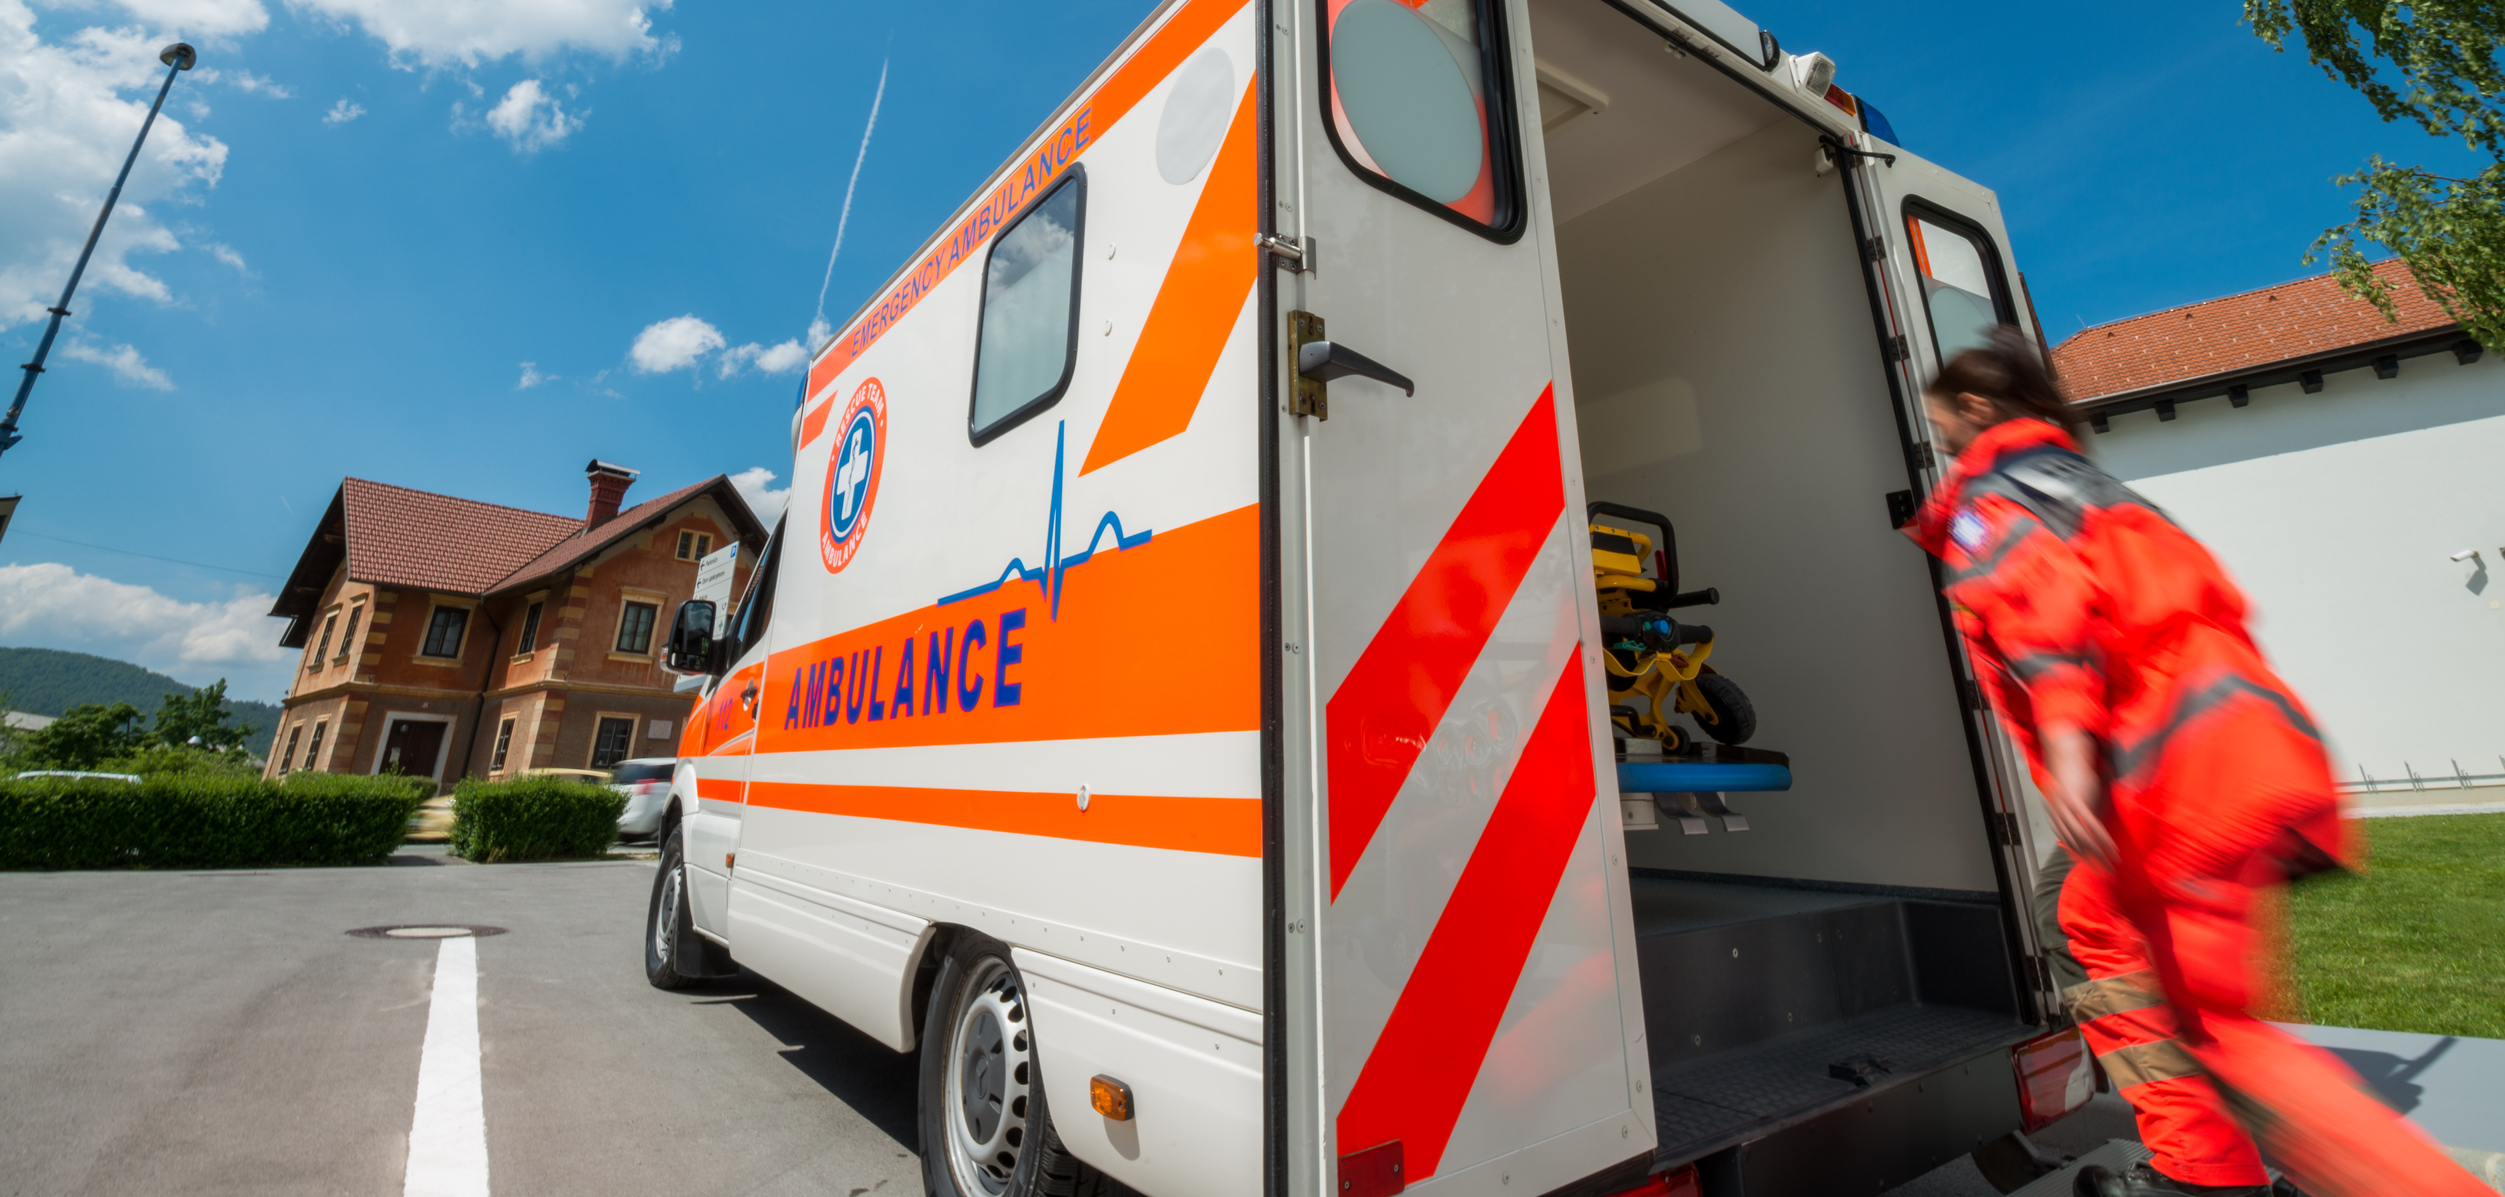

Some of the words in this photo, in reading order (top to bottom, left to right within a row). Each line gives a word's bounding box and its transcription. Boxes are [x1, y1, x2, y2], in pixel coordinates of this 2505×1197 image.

[851, 246, 946, 358] EMERGENCY
[947, 106, 1092, 270] AMBULANCE
[835, 387, 867, 448] RESCUE
[867, 383, 884, 418] TEAM
[821, 511, 868, 568] AMBULANCE
[784, 607, 1027, 731] AMBULANCE
[717, 698, 733, 731] 112
